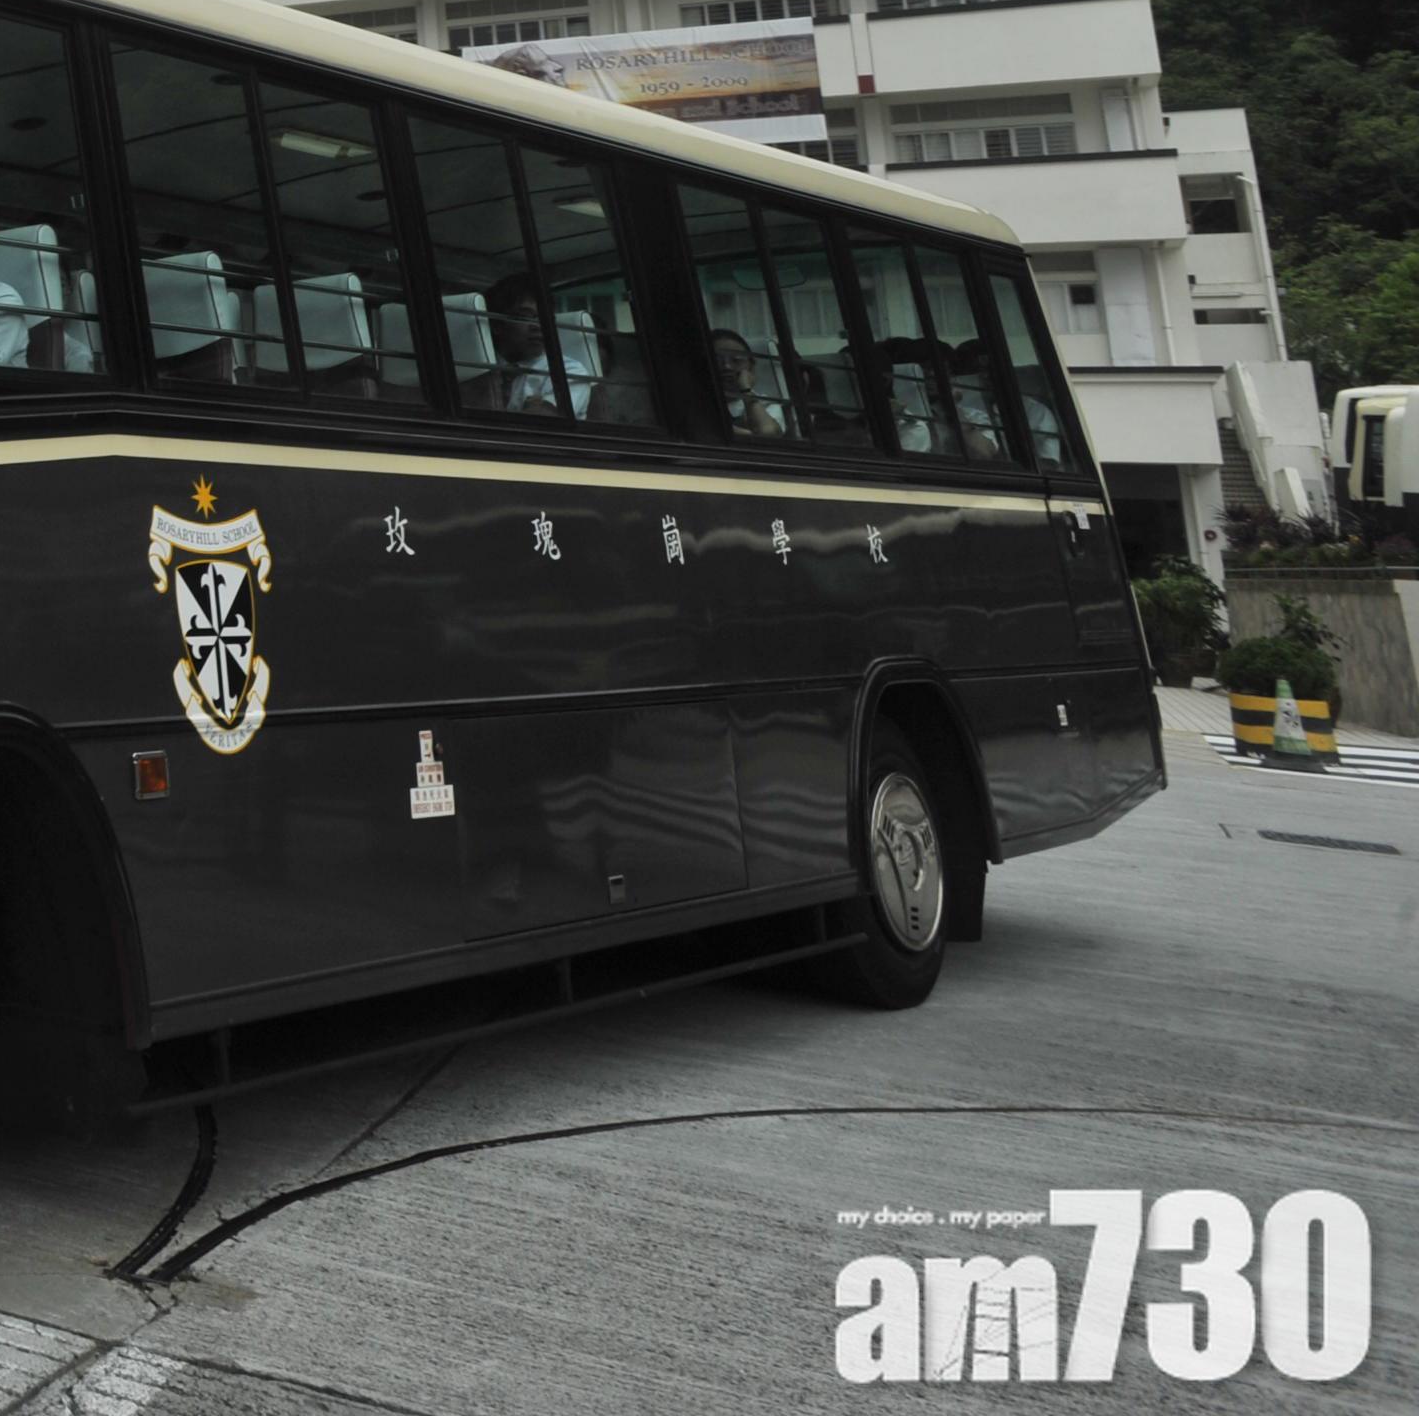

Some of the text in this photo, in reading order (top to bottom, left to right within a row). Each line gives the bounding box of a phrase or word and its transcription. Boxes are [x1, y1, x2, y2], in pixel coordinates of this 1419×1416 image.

[576, 48, 716, 71] ROSARYHILL
[641, 81, 680, 96] 1959
[702, 76, 749, 89] 2009
[157, 516, 257, 545] ROSARYHILL SCHOOL
